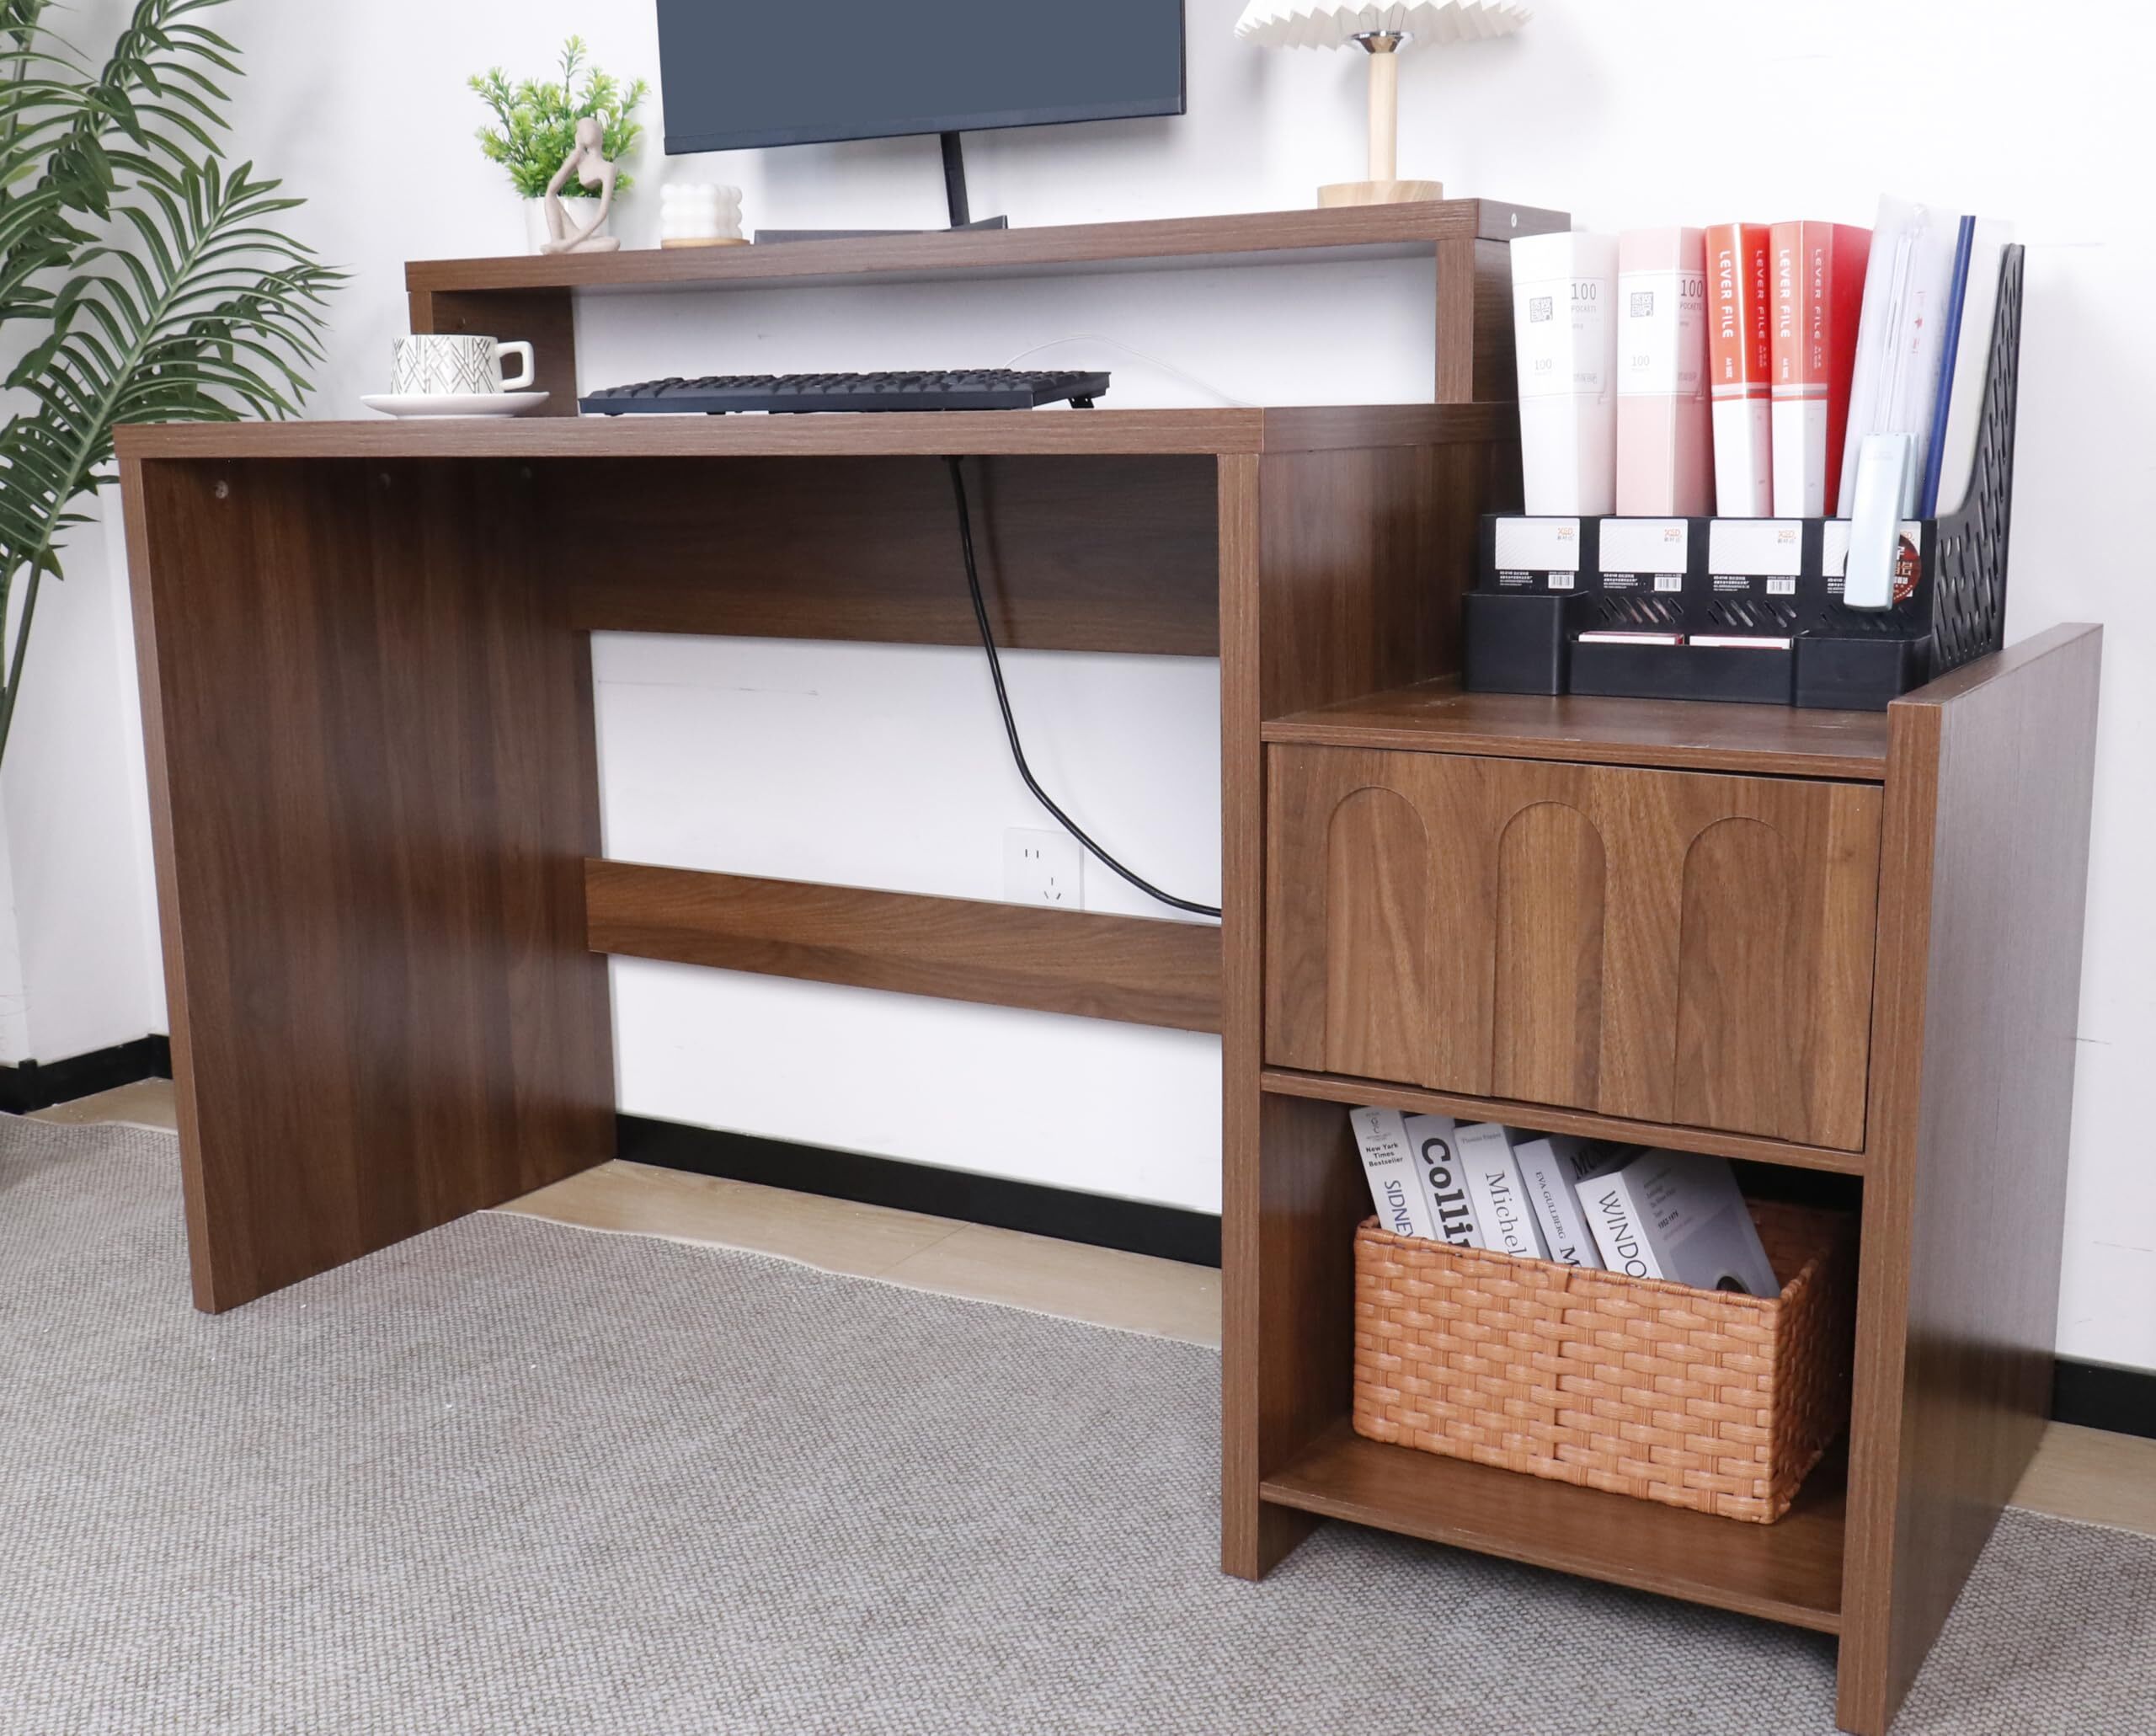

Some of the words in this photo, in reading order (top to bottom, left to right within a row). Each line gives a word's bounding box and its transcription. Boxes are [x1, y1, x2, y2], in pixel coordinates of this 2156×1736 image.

[1571, 283, 1597, 301] 100
[1680, 279, 1704, 297] 100
[1720, 251, 1732, 299] LEVER
[1756, 250, 1764, 299] LEVER
[1780, 249, 1790, 298] LEVER
[1721, 306, 1733, 338] FILE
[1780, 305, 1790, 338] FILE
[1534, 358, 1553, 370] 100
[1630, 355, 1650, 366] 100
[1485, 1170, 1527, 1255] Michel
[1535, 1171, 1546, 1189] EVA
[1543, 1191, 1566, 1240] GULLBERG
[1598, 1190, 1649, 1279] WINDO
